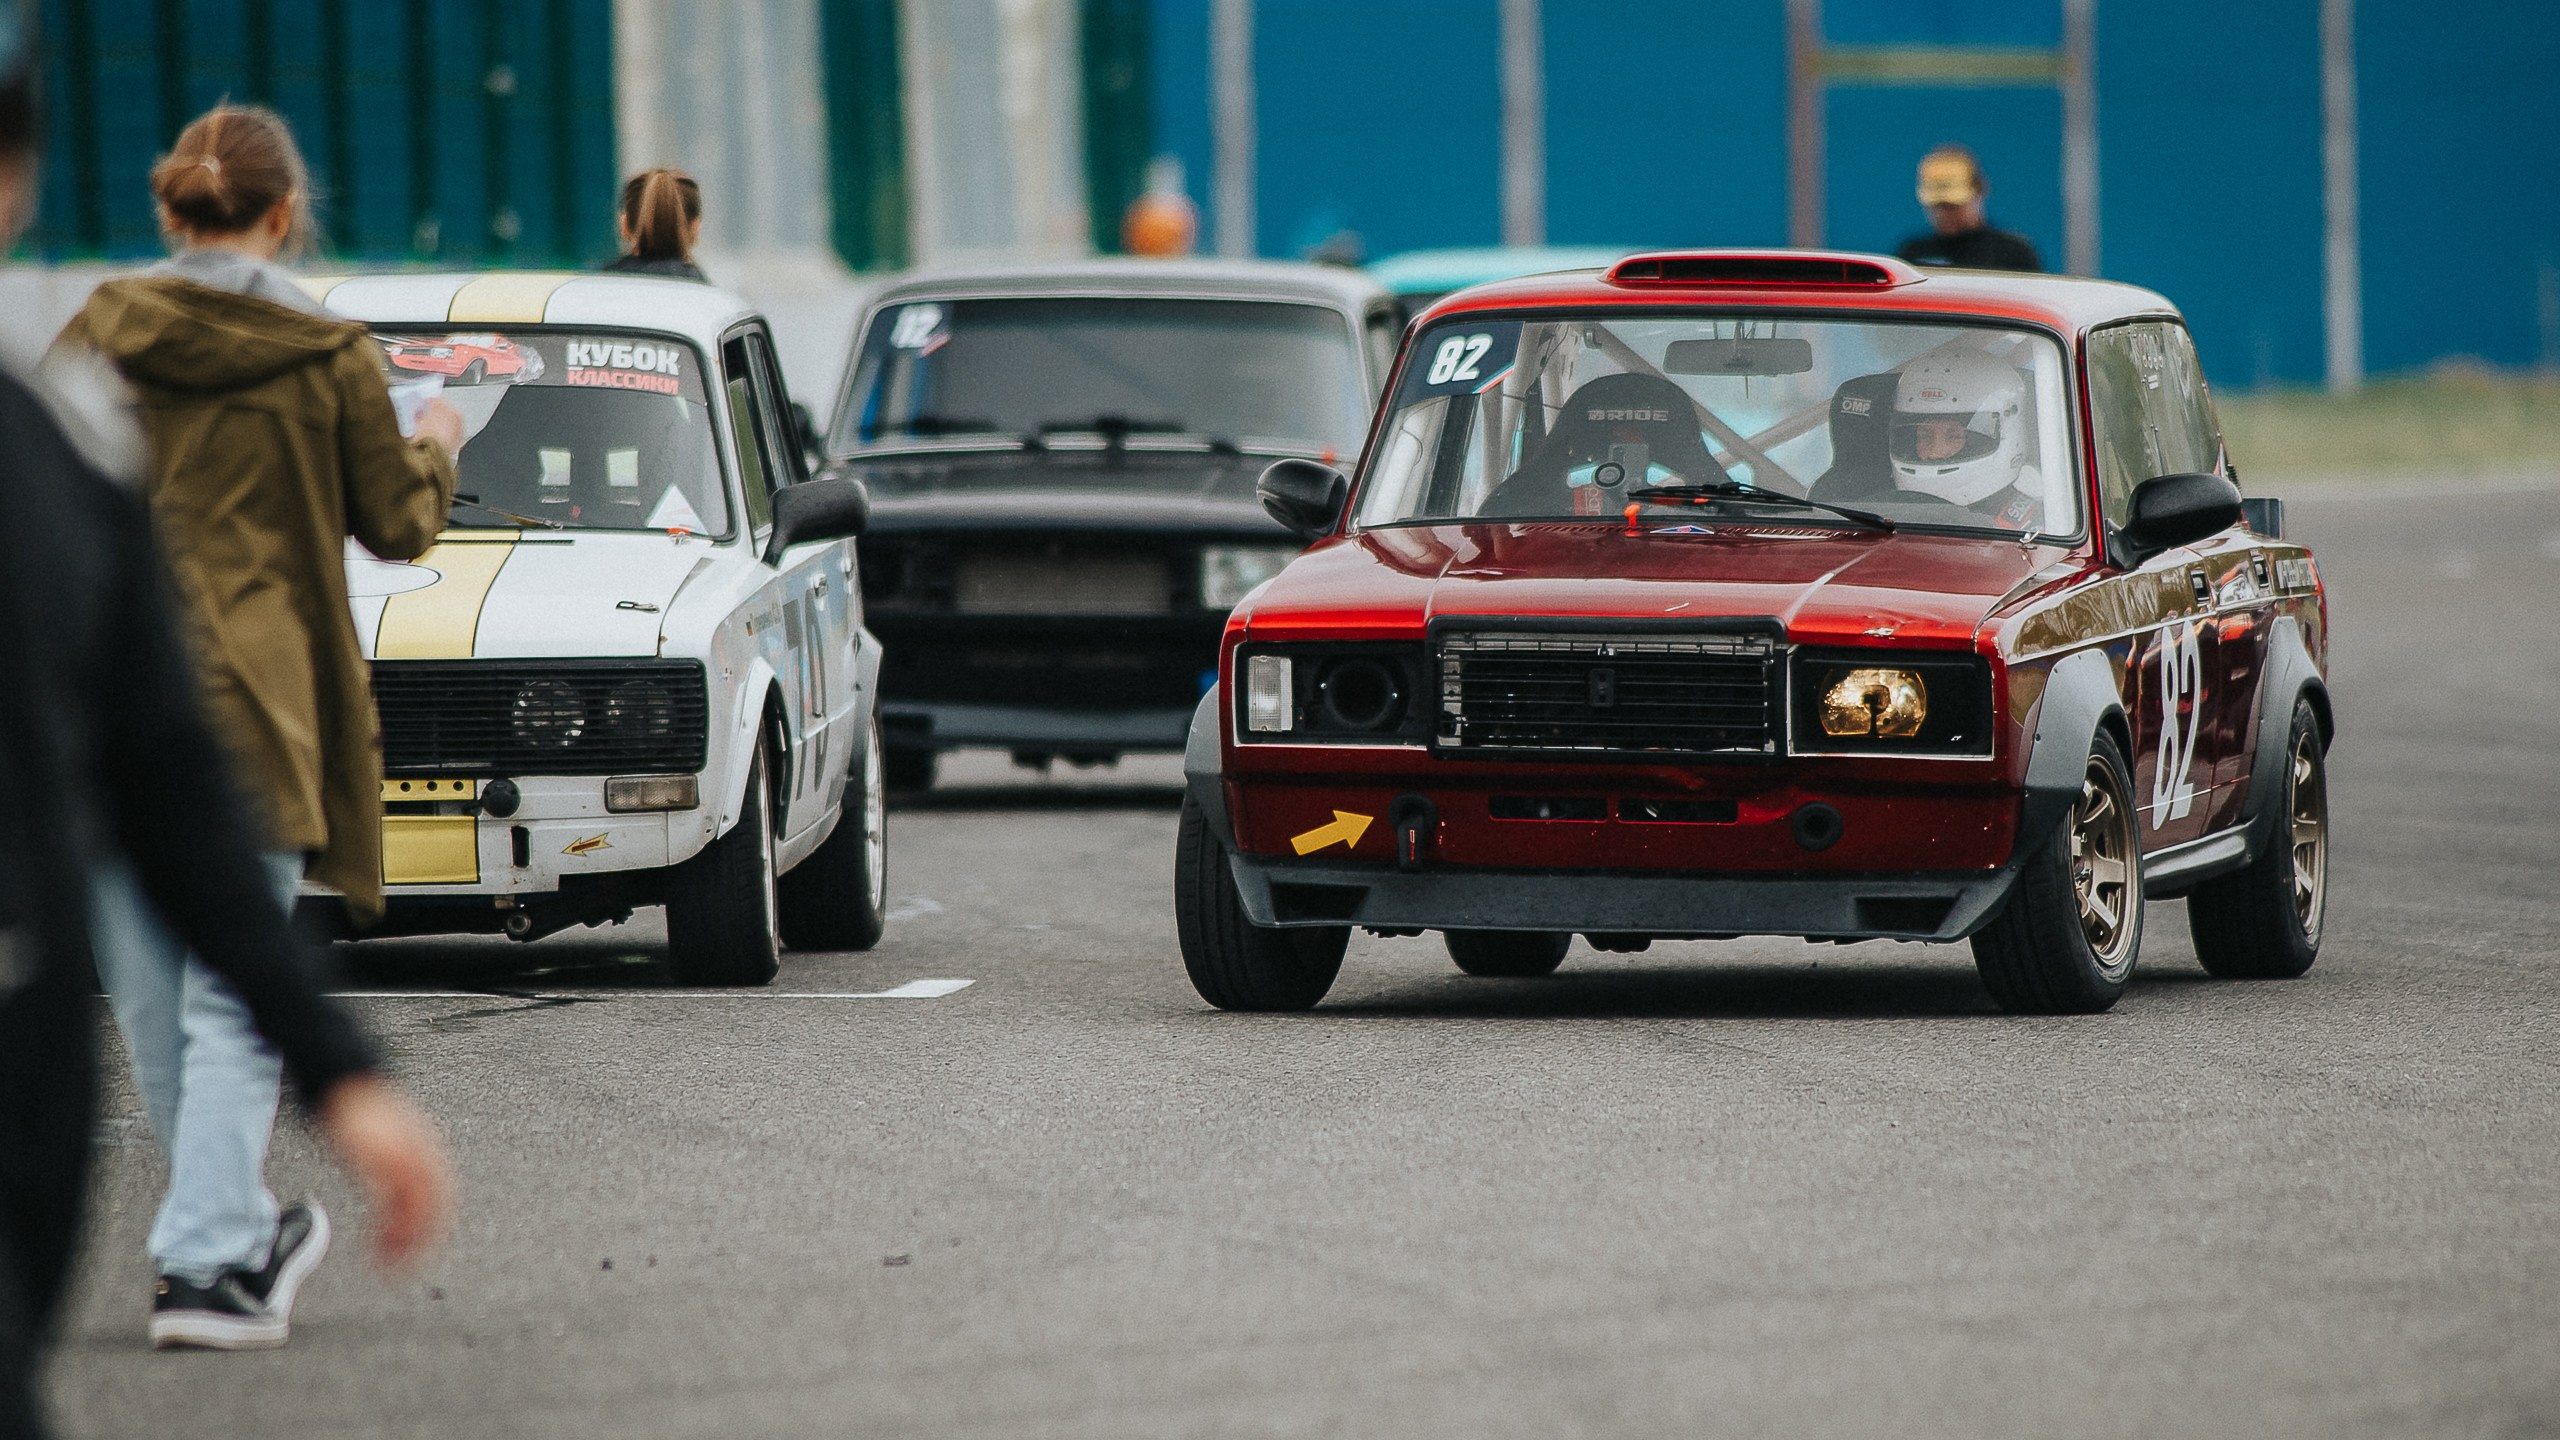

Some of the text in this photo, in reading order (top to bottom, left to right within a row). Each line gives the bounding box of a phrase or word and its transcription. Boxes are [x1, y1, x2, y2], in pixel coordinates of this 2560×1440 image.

[567, 343, 679, 375] КУБОК
[1427, 335, 1492, 385] 82
[567, 370, 678, 395] КЛАССИКИ
[1587, 409, 1669, 421] BRIDE
[1841, 399, 1871, 414] OMP
[2152, 619, 2201, 831] 82
